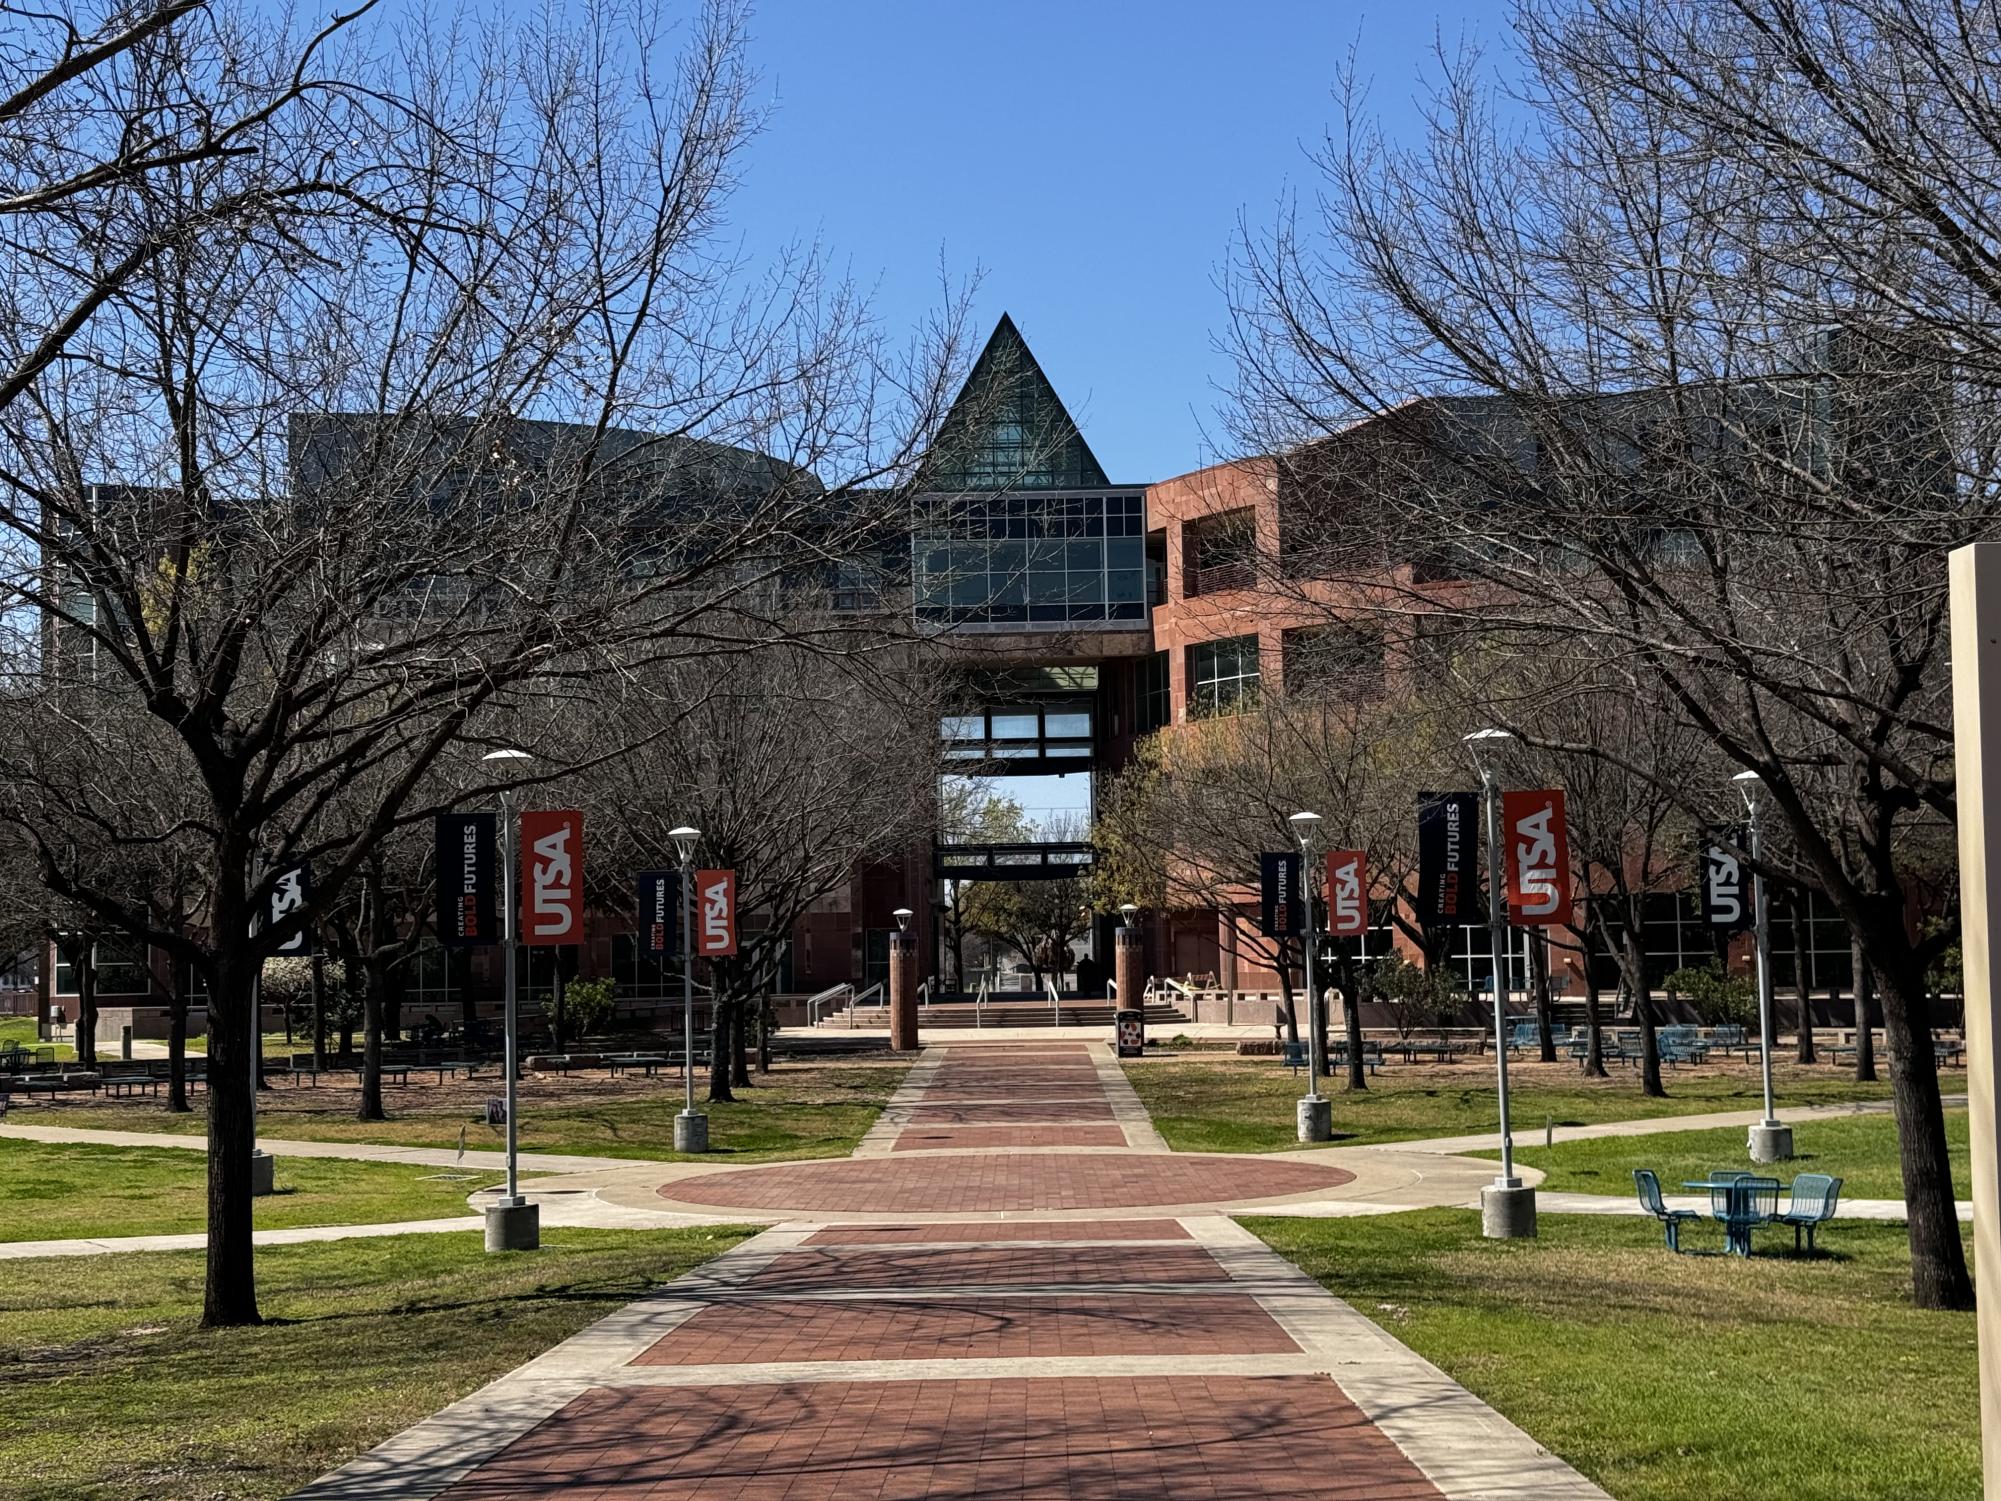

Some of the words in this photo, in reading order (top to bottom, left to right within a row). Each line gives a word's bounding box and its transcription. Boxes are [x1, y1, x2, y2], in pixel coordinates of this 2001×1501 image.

[464, 825, 477, 893] FUTURES
[1447, 803, 1460, 872] FUTURES
[533, 827, 573, 936] UTSA
[1278, 860, 1287, 904] FUTURES
[1516, 807, 1559, 916] UTSA
[656, 879, 665, 923] FUTURES
[704, 881, 730, 950] UTSA
[1335, 861, 1361, 930] UTSA
[1437, 873, 1446, 914] CREATING
[1444, 872, 1458, 915] BOLD
[457, 896, 465, 937] CREATING
[465, 895, 478, 937] BOLD
[655, 923, 664, 950] BOLD
[1278, 904, 1287, 931] BOLD
